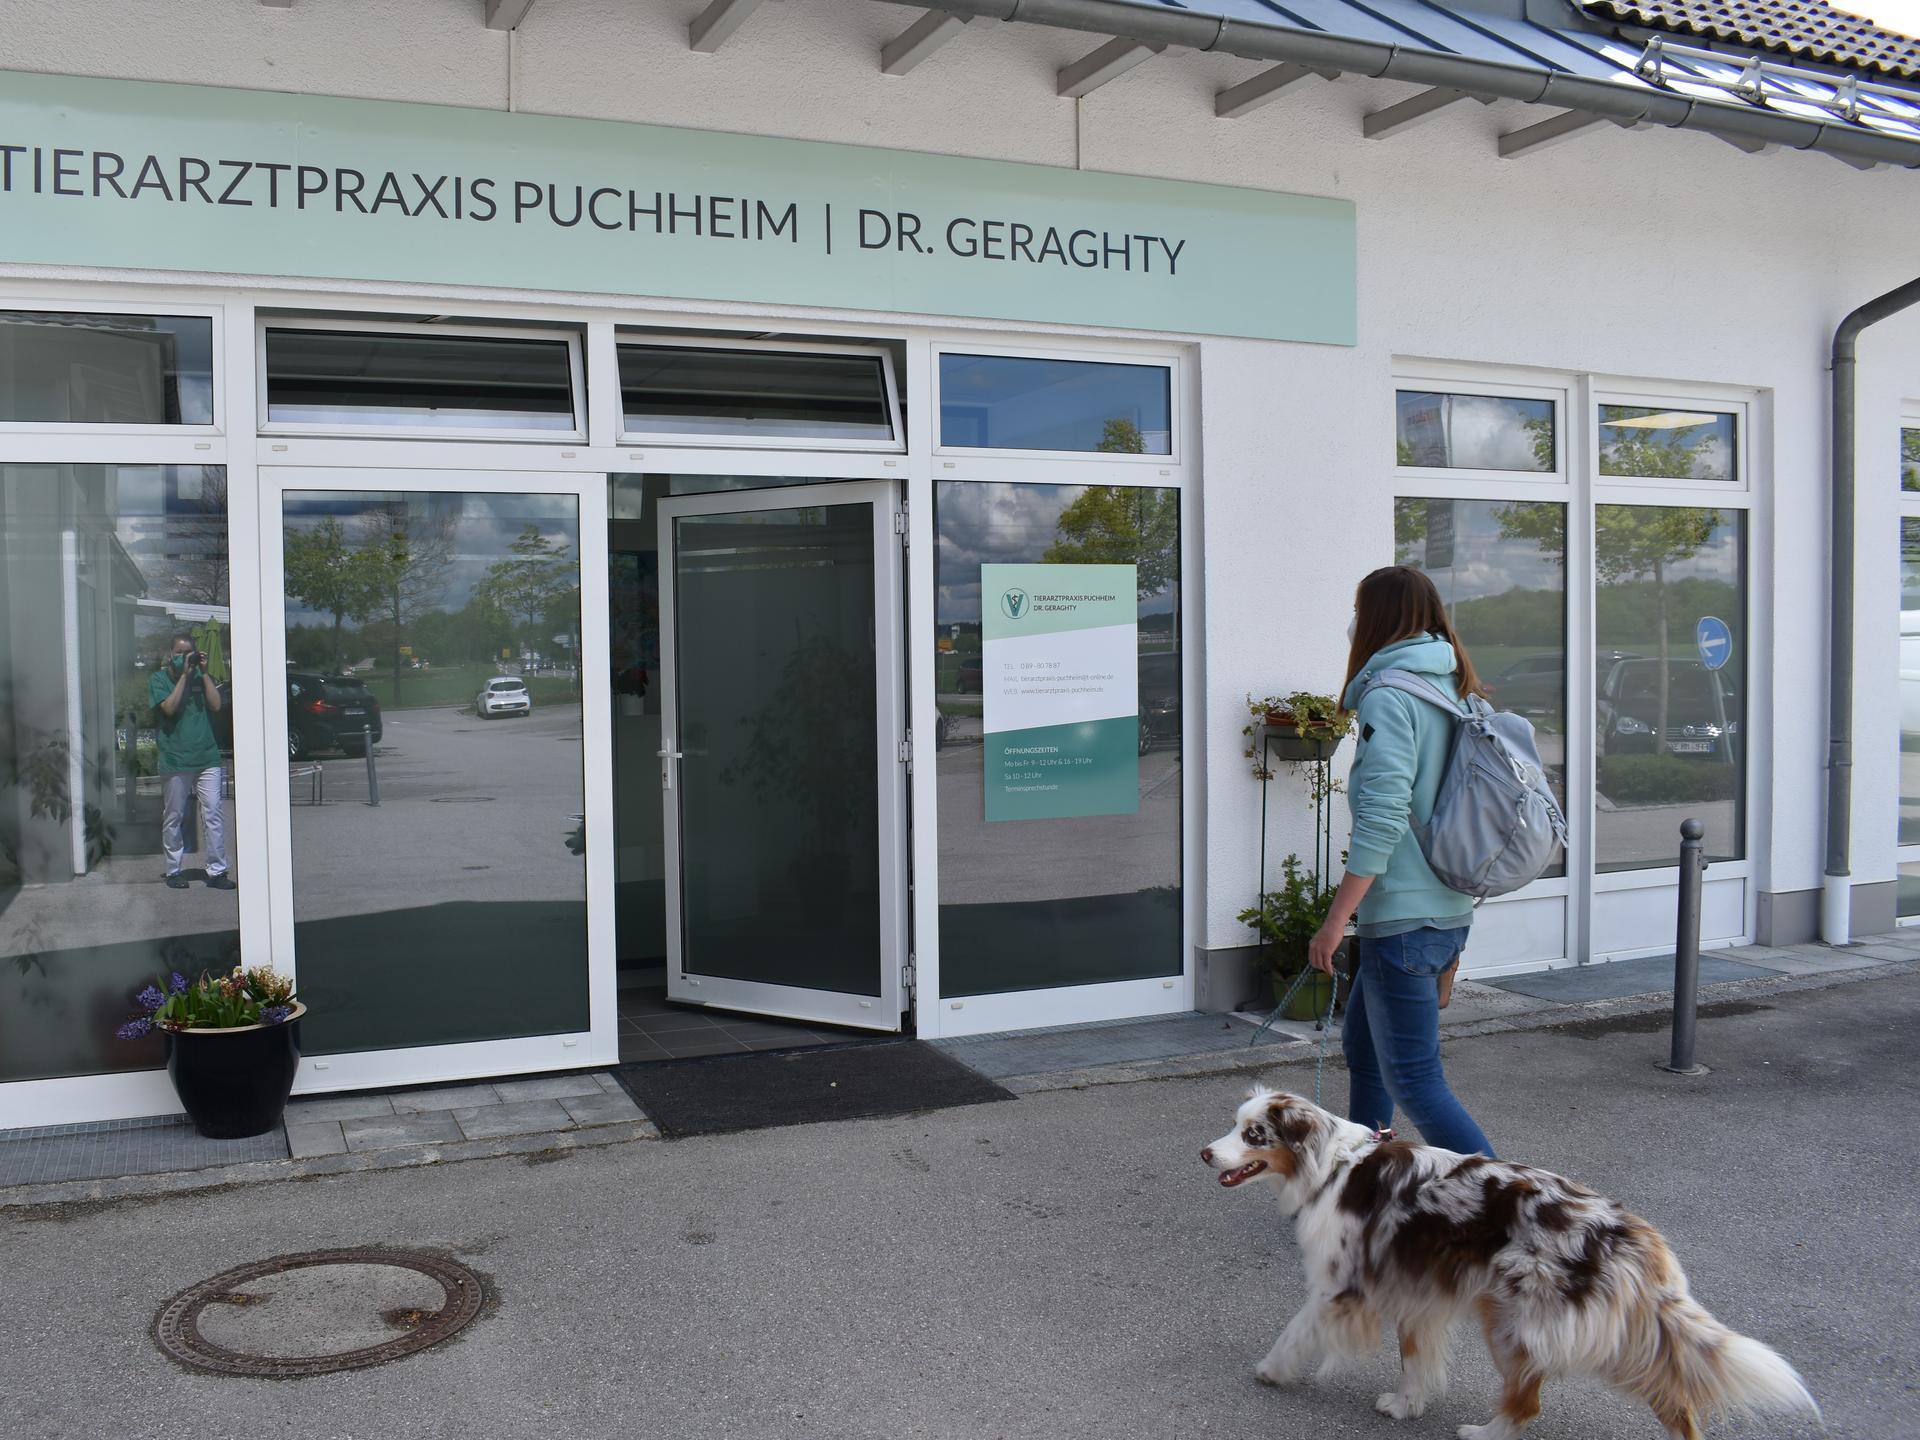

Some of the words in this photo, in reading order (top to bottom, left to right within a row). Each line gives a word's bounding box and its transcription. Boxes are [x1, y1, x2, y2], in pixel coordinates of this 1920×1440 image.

[0, 145, 496, 221] TIERARZTPRAXIS
[515, 182, 797, 242] PUCHHEIM
[860, 209, 933, 253] DR.
[947, 218, 1185, 274] GERAGHTY
[1044, 604, 1077, 612] GERAGHTY
[1004, 746, 1059, 754] ÖFFNUNGSZEITEN
